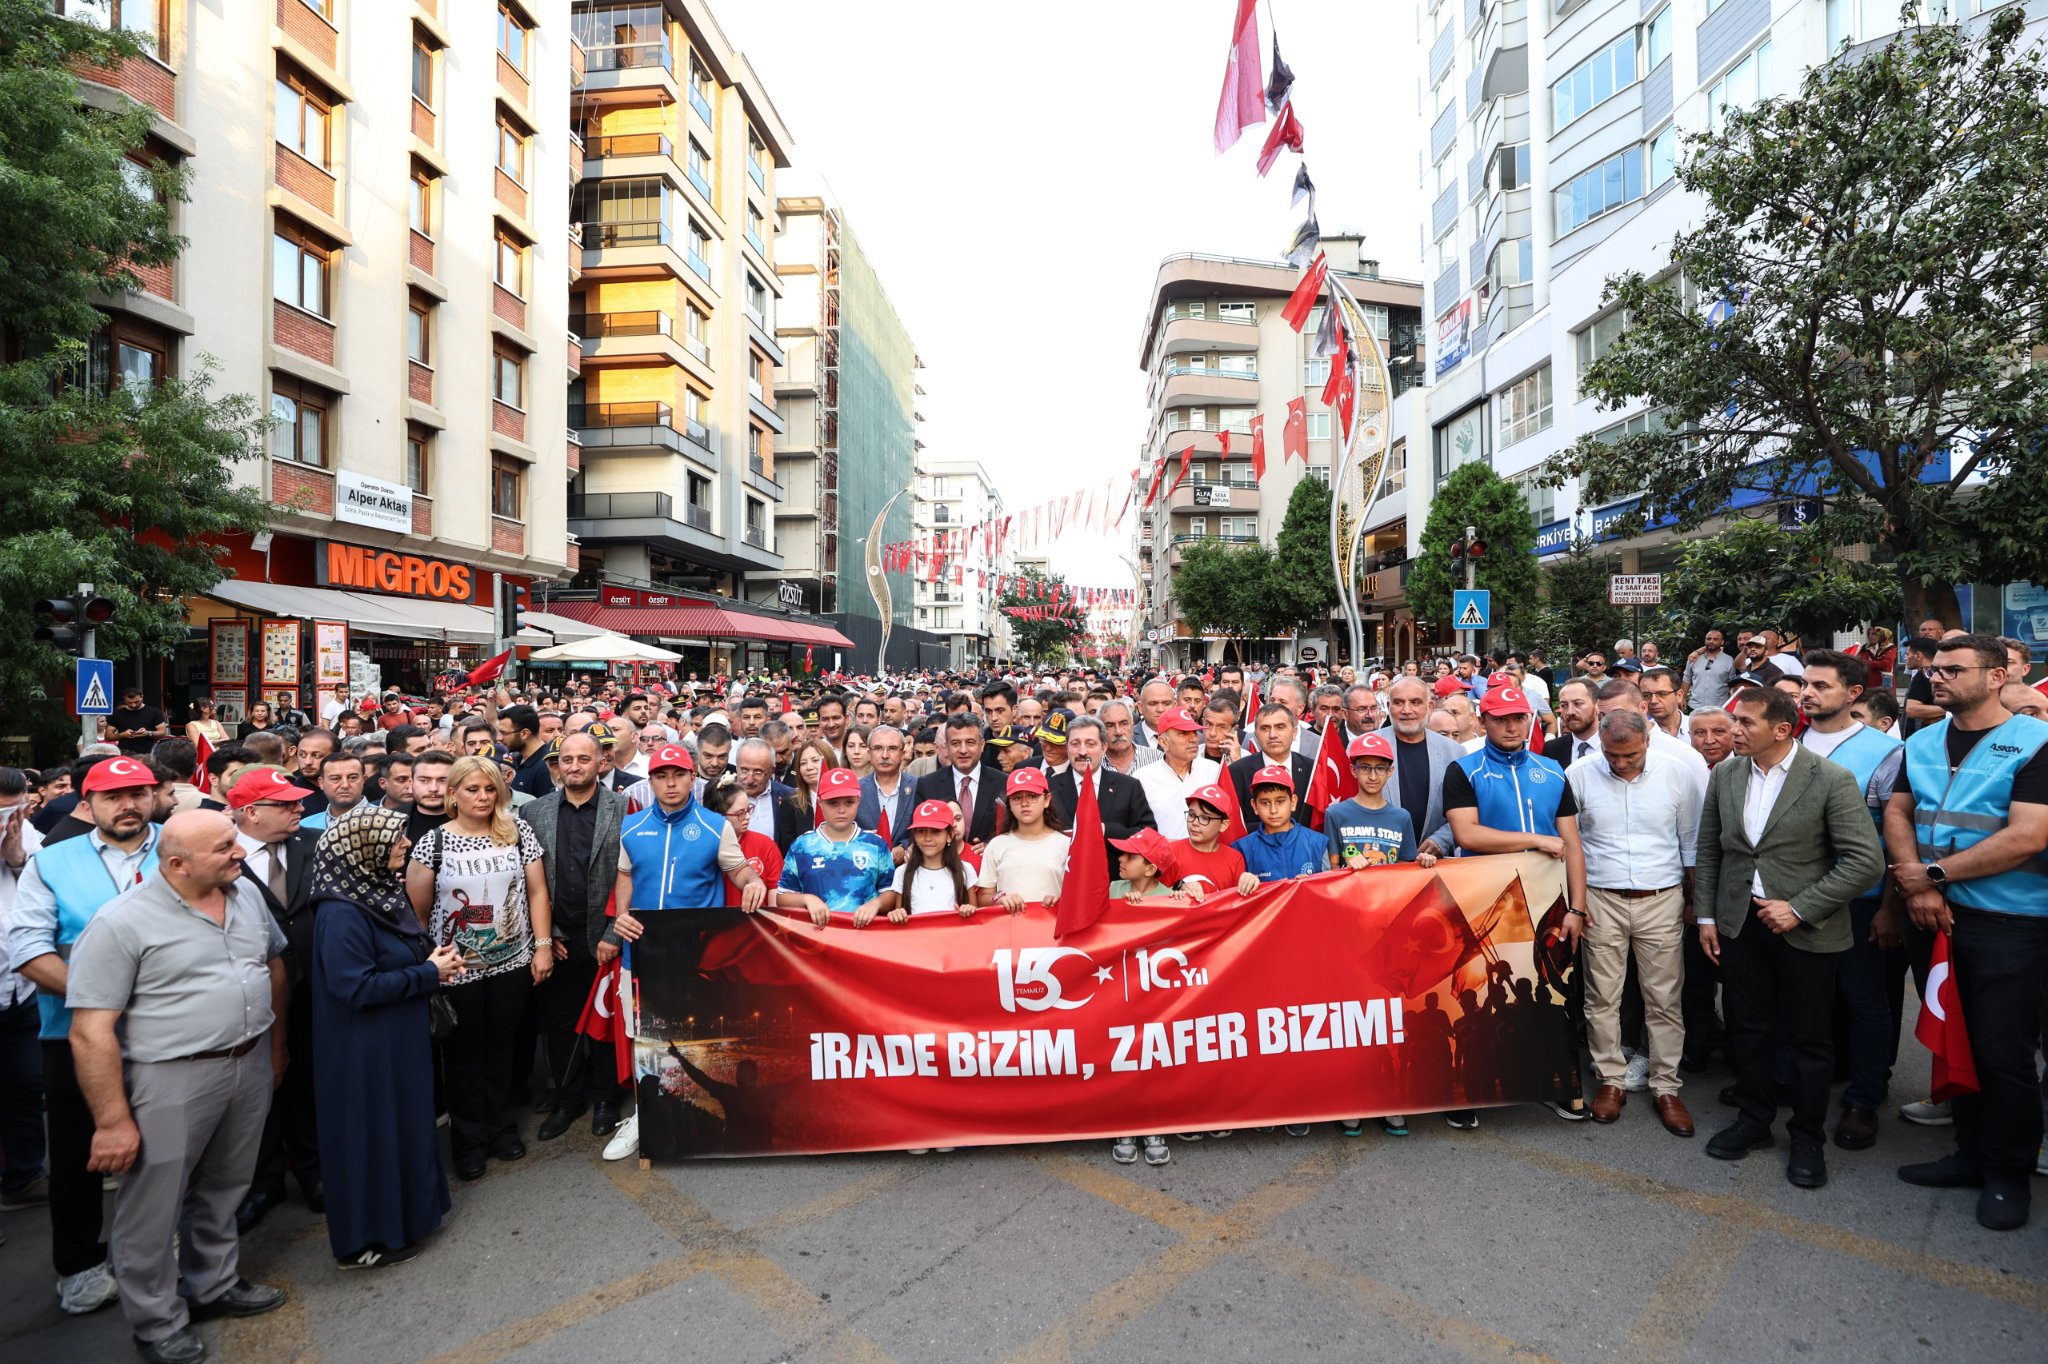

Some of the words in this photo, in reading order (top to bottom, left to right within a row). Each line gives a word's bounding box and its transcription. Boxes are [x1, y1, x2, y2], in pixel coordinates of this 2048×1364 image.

[348, 489, 377, 506] Alper
[379, 496, 407, 515] Aktaş
[1637, 575, 1660, 584] TAKSİ
[610, 595, 631, 604] ÖZSÜT
[648, 595, 669, 604] ÖZSÜT
[1340, 826, 1376, 837] BRAWL
[1377, 828, 1403, 842] STARS
[444, 852, 518, 877] SHOES
[1016, 987, 1045, 995] TEMMUZ
[810, 1032, 939, 1080] İRADE
[1108, 1012, 1248, 1072] ZAFER
